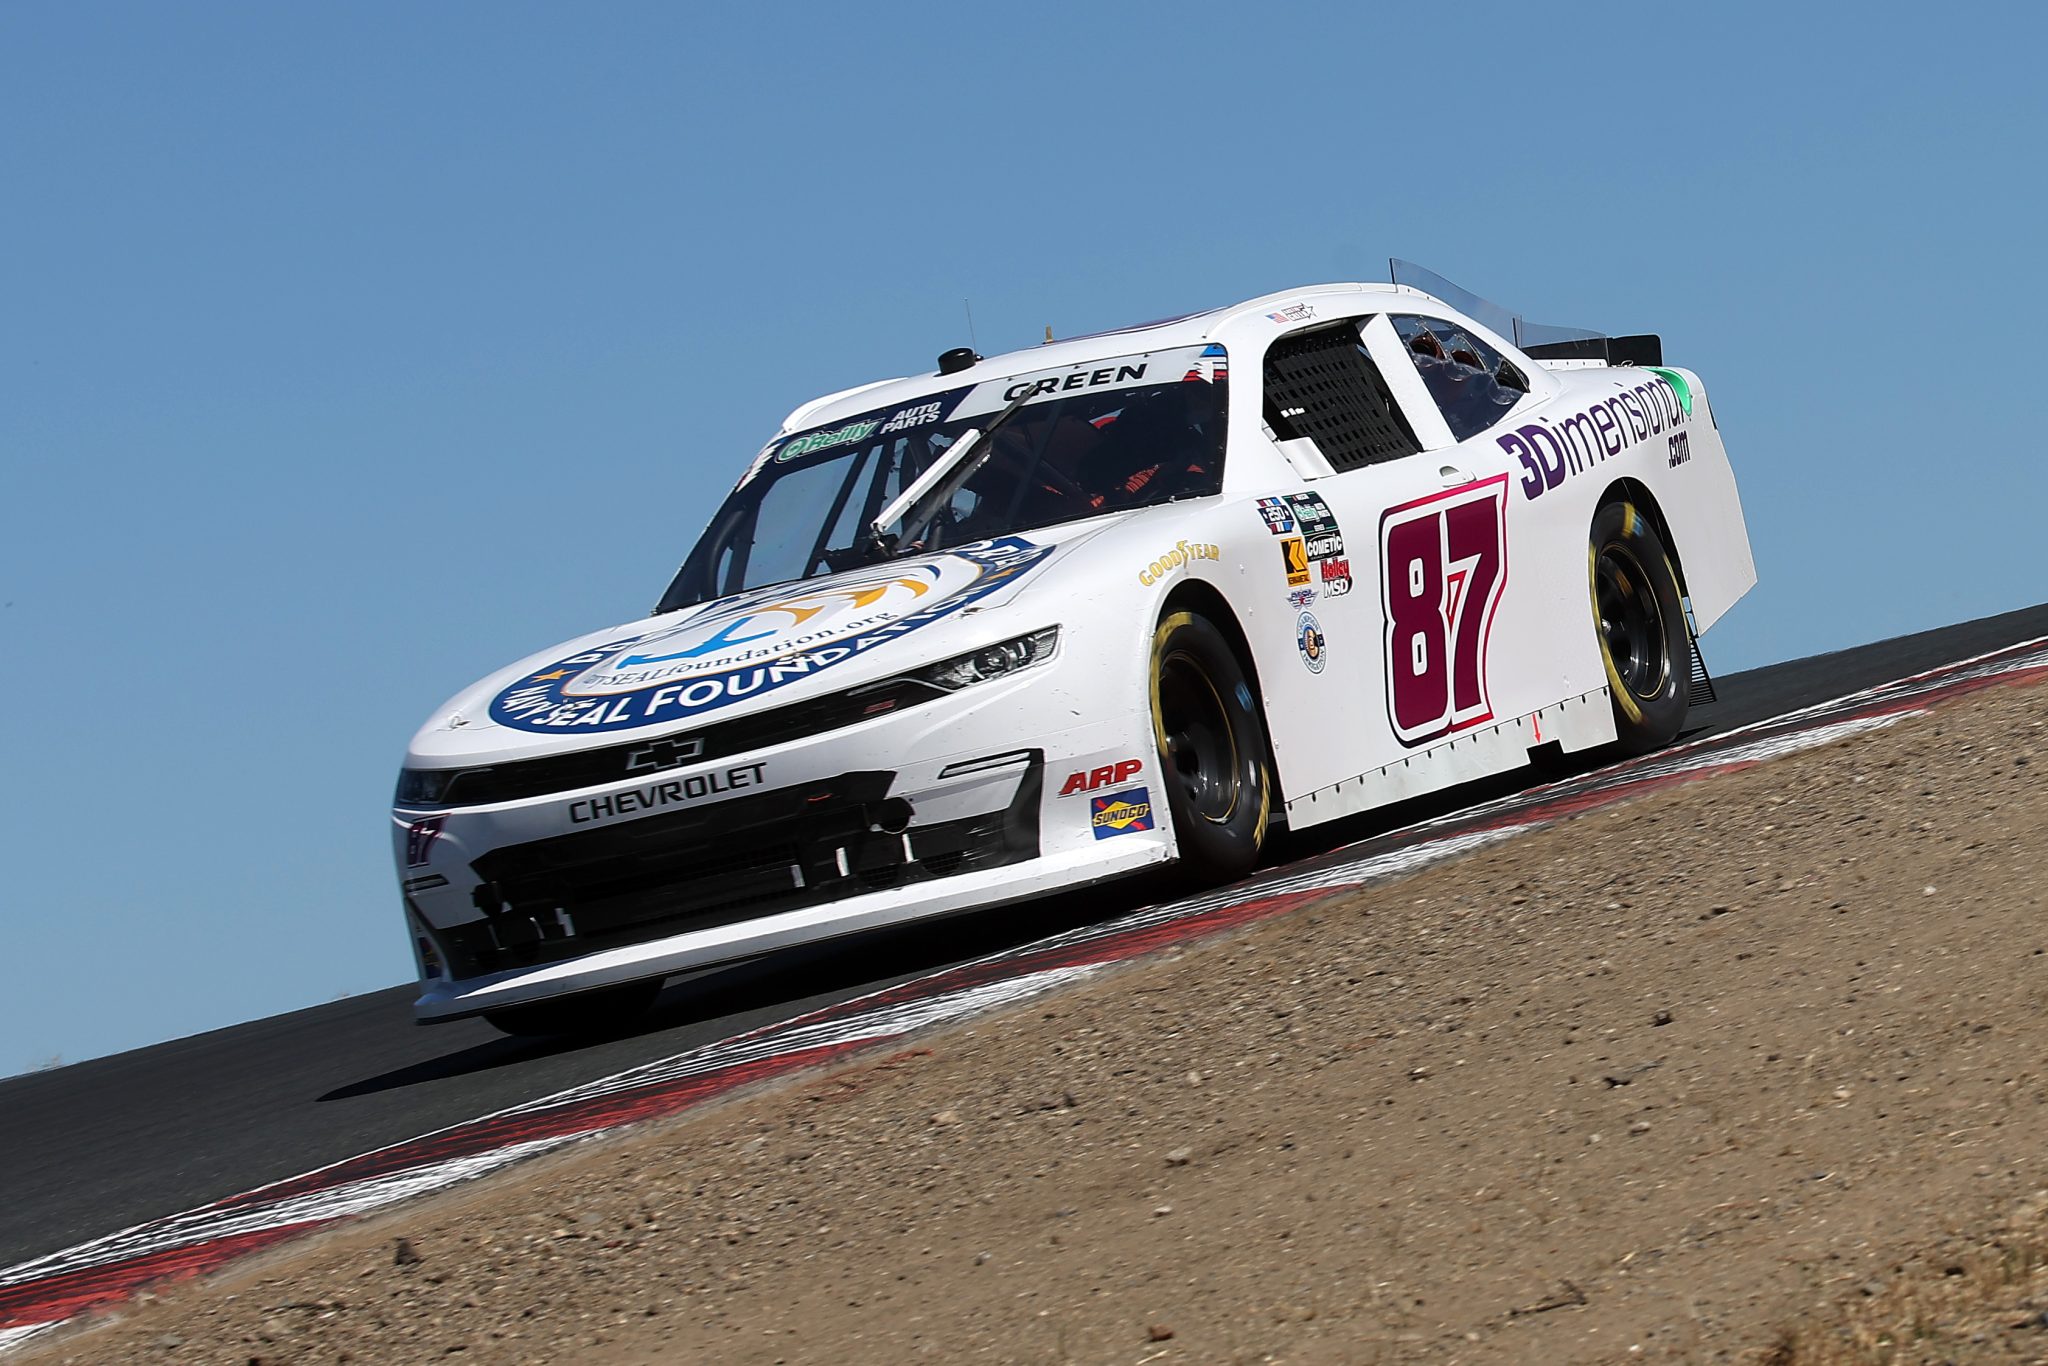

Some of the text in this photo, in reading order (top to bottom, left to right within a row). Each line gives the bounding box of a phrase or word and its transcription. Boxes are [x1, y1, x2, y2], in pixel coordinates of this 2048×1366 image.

[1002, 363, 1148, 402] GREEN
[880, 411, 941, 434] PARTS
[892, 402, 942, 421] AUTO
[777, 419, 877, 462] O'Reilly
[1668, 430, 1691, 469] .com
[1265, 506, 1286, 522] 250
[1306, 534, 1343, 557] COMETIC
[1139, 540, 1219, 586] GOODYEAR
[1324, 579, 1350, 598] MSD
[1386, 491, 1501, 733] 87
[531, 697, 633, 727] SEAL
[569, 762, 768, 825] CHEVROLET
[1058, 760, 1143, 796] ARP
[1095, 804, 1147, 826] SUNOCO
